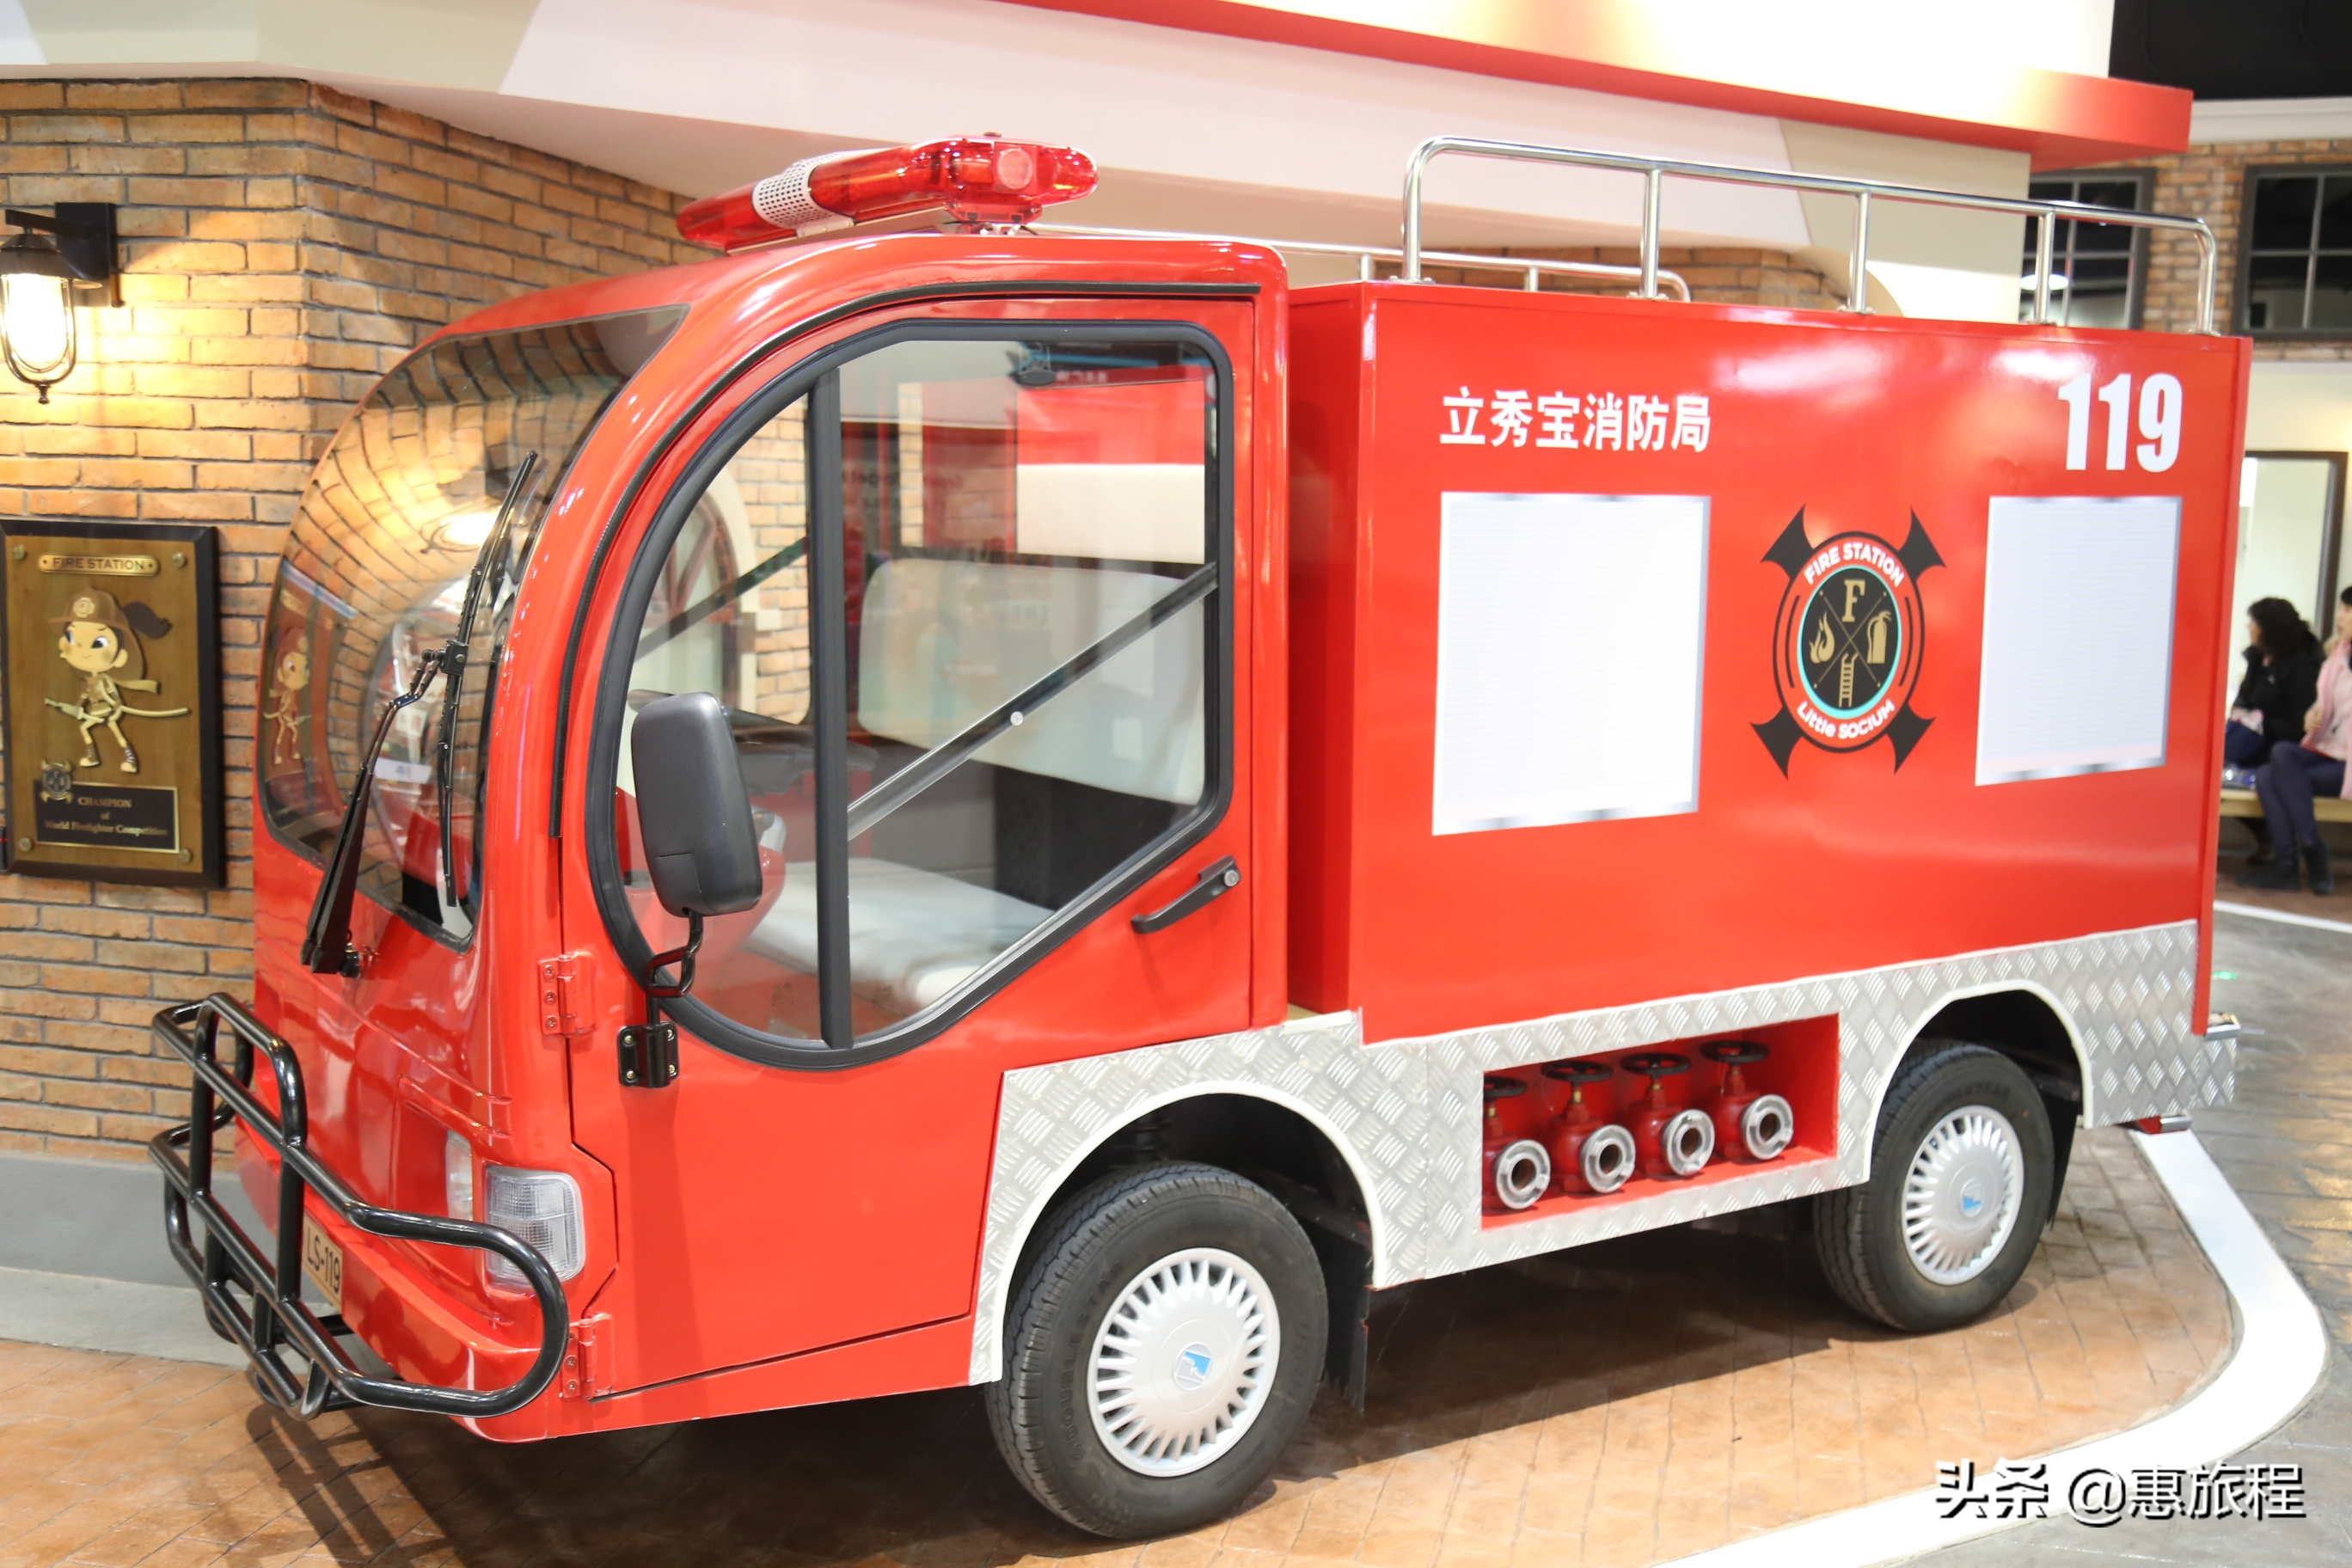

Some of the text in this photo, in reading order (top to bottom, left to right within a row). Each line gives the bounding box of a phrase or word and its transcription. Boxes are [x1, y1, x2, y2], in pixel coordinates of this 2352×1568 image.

[1439, 385, 1712, 453] 立秀宝消防局
[2057, 372, 2183, 473] 119
[52, 557, 144, 570] FIRE STATION
[1804, 542, 1905, 587] FIRE STATION
[1841, 579, 1865, 622] F
[1837, 699, 1896, 739] SOCIUM
